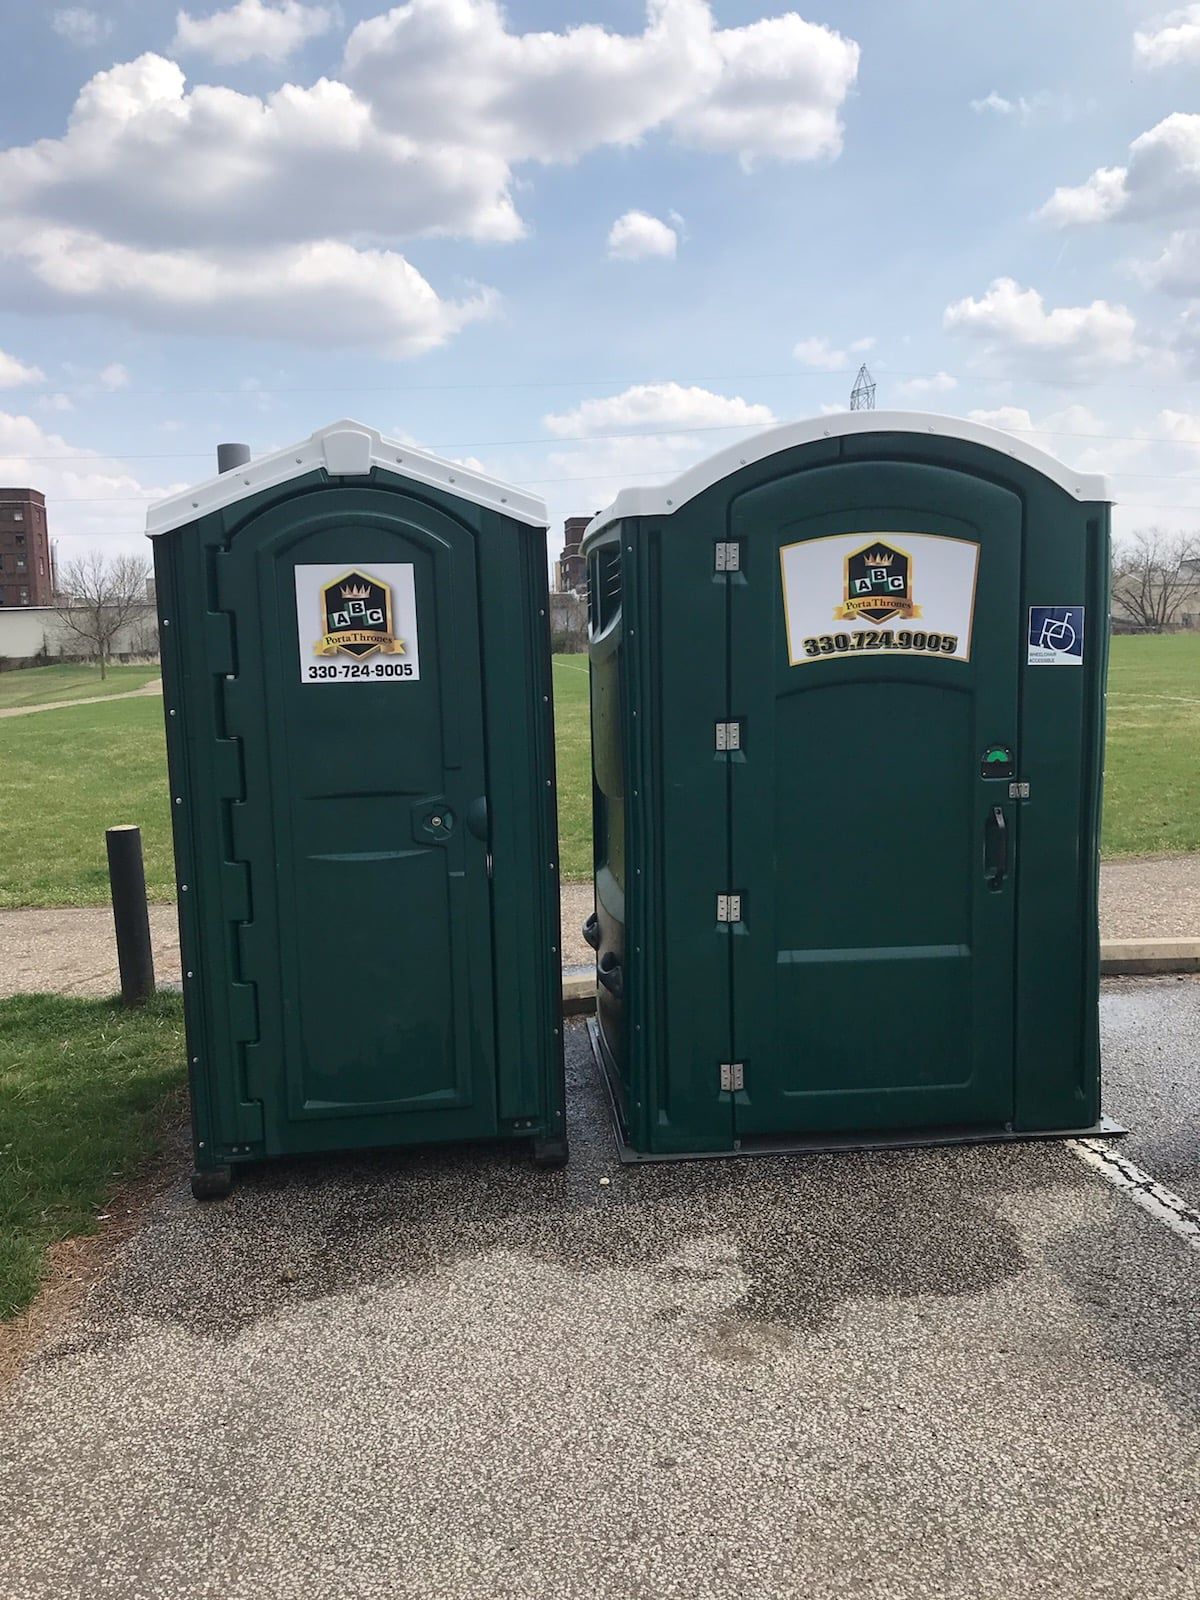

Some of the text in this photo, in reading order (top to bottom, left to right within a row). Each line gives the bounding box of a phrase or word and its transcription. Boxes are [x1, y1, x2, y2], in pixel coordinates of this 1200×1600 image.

[858, 569, 903, 591] ABC
[336, 602, 382, 625] ABC
[803, 630, 958, 657] 330.724.9005
[308, 664, 413, 679] 330-724-9005
